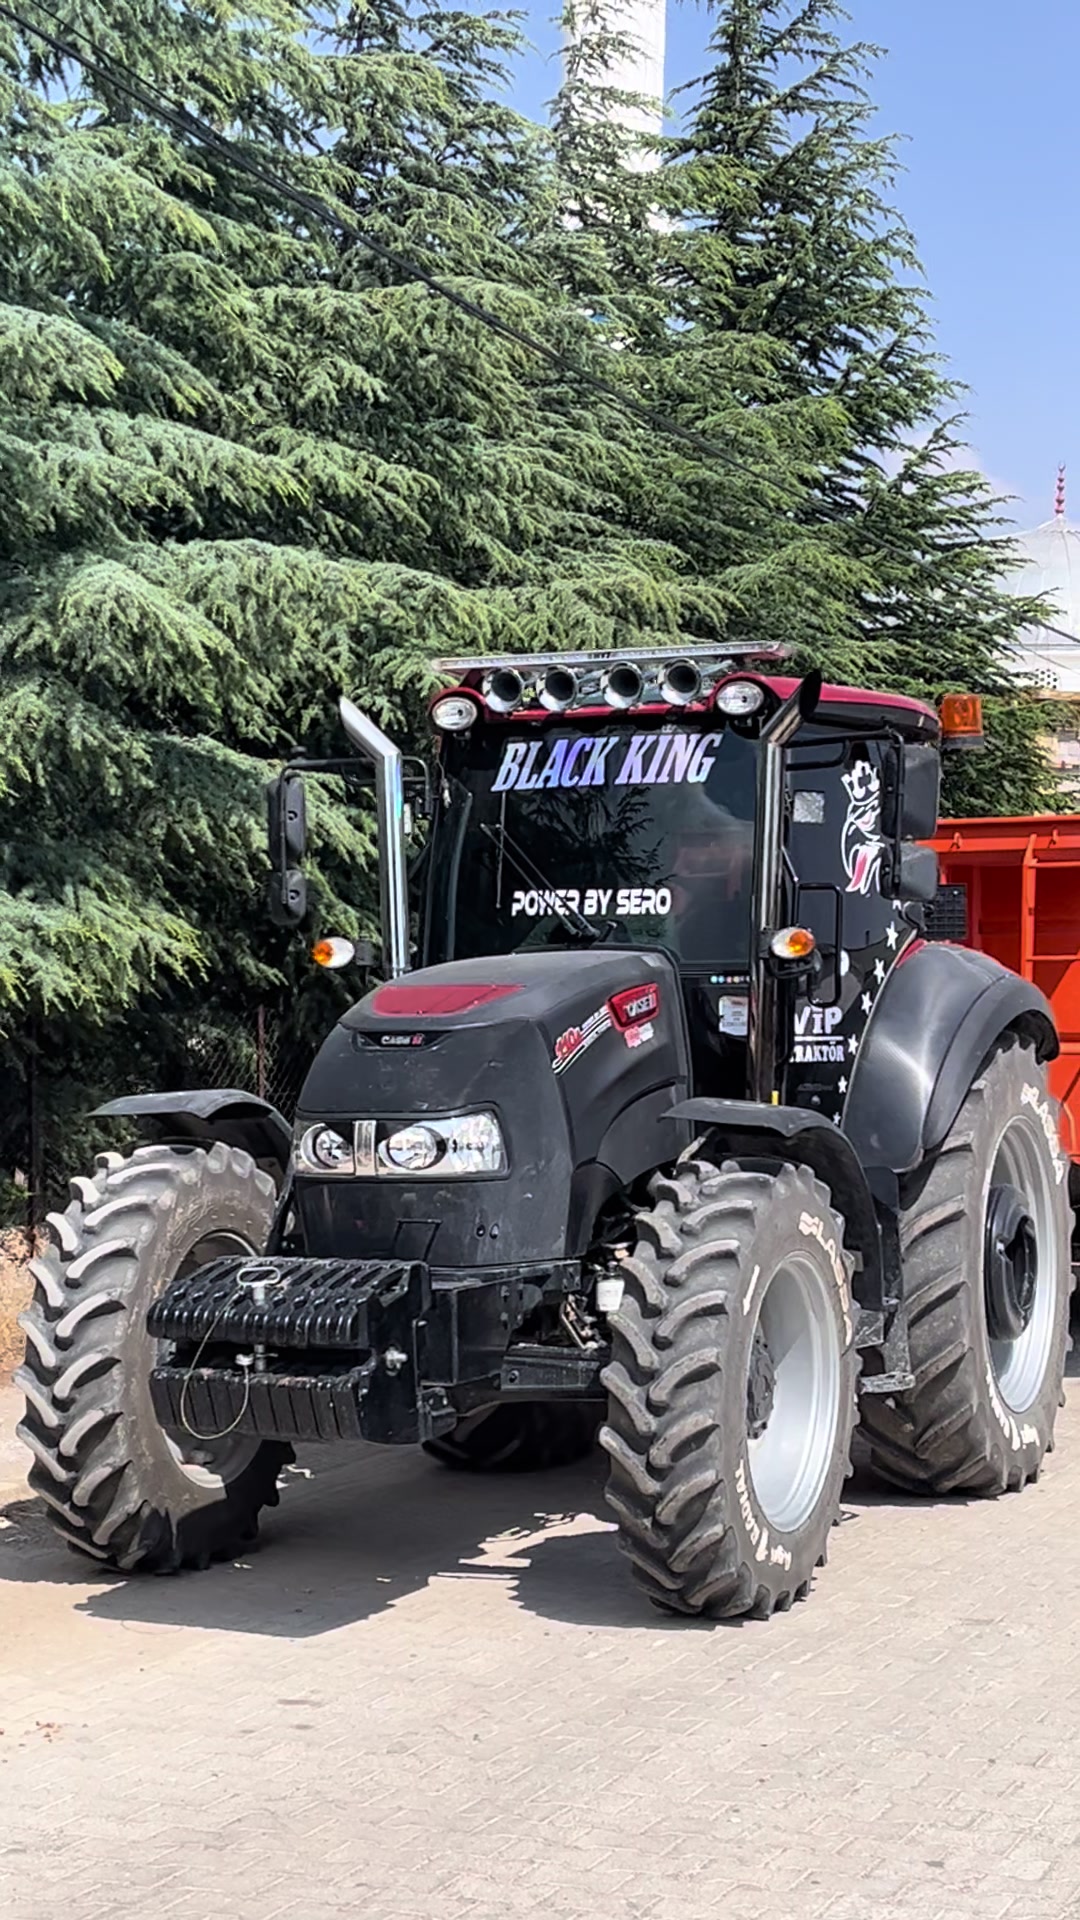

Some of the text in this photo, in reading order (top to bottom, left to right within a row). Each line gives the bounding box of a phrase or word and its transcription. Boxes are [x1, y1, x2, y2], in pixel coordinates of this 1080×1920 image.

[491, 735, 619, 792] BLACK
[511, 887, 672, 917] POWER BY SERO
[789, 1041, 845, 1063] RAKTÖR
